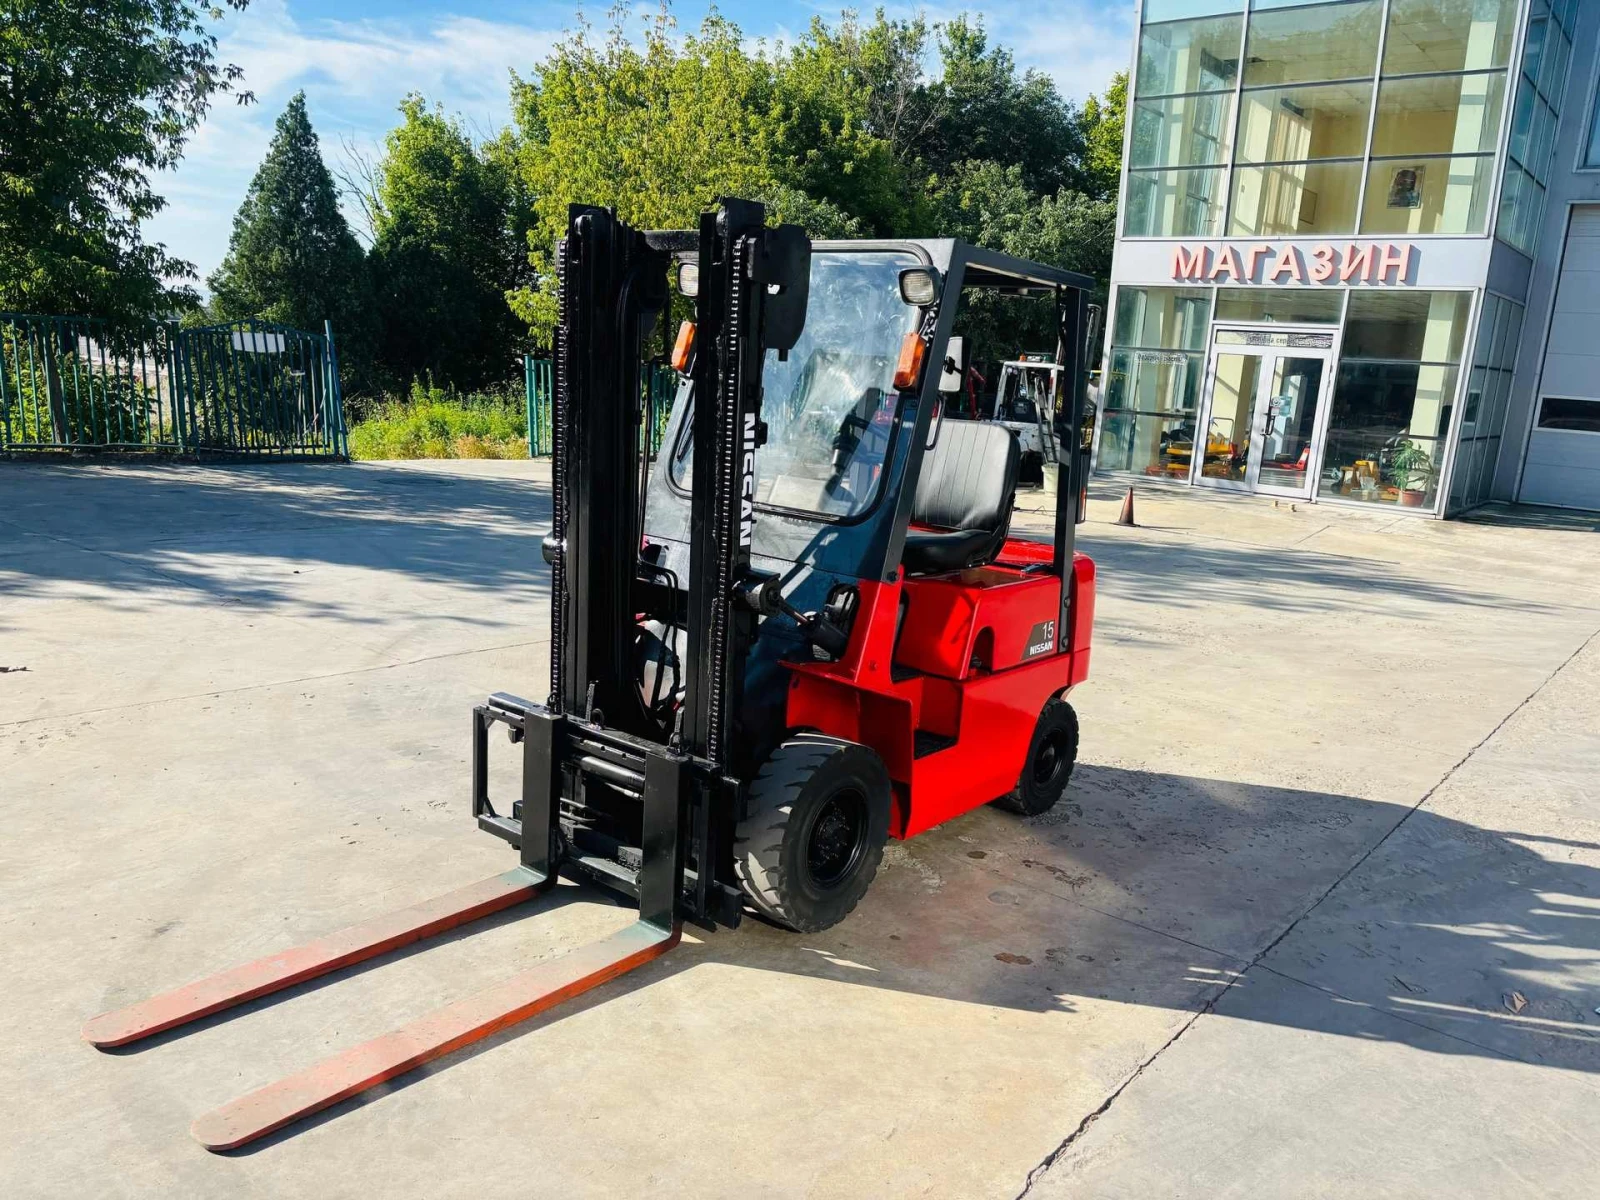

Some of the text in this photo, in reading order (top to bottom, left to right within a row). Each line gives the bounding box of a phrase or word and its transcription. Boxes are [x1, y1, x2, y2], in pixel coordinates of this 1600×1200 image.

[1171, 243, 1412, 282] МАГАЗИН
[739, 412, 756, 547] NISSAN
[1042, 620, 1055, 640] 15
[1029, 640, 1054, 656] NISSAN
